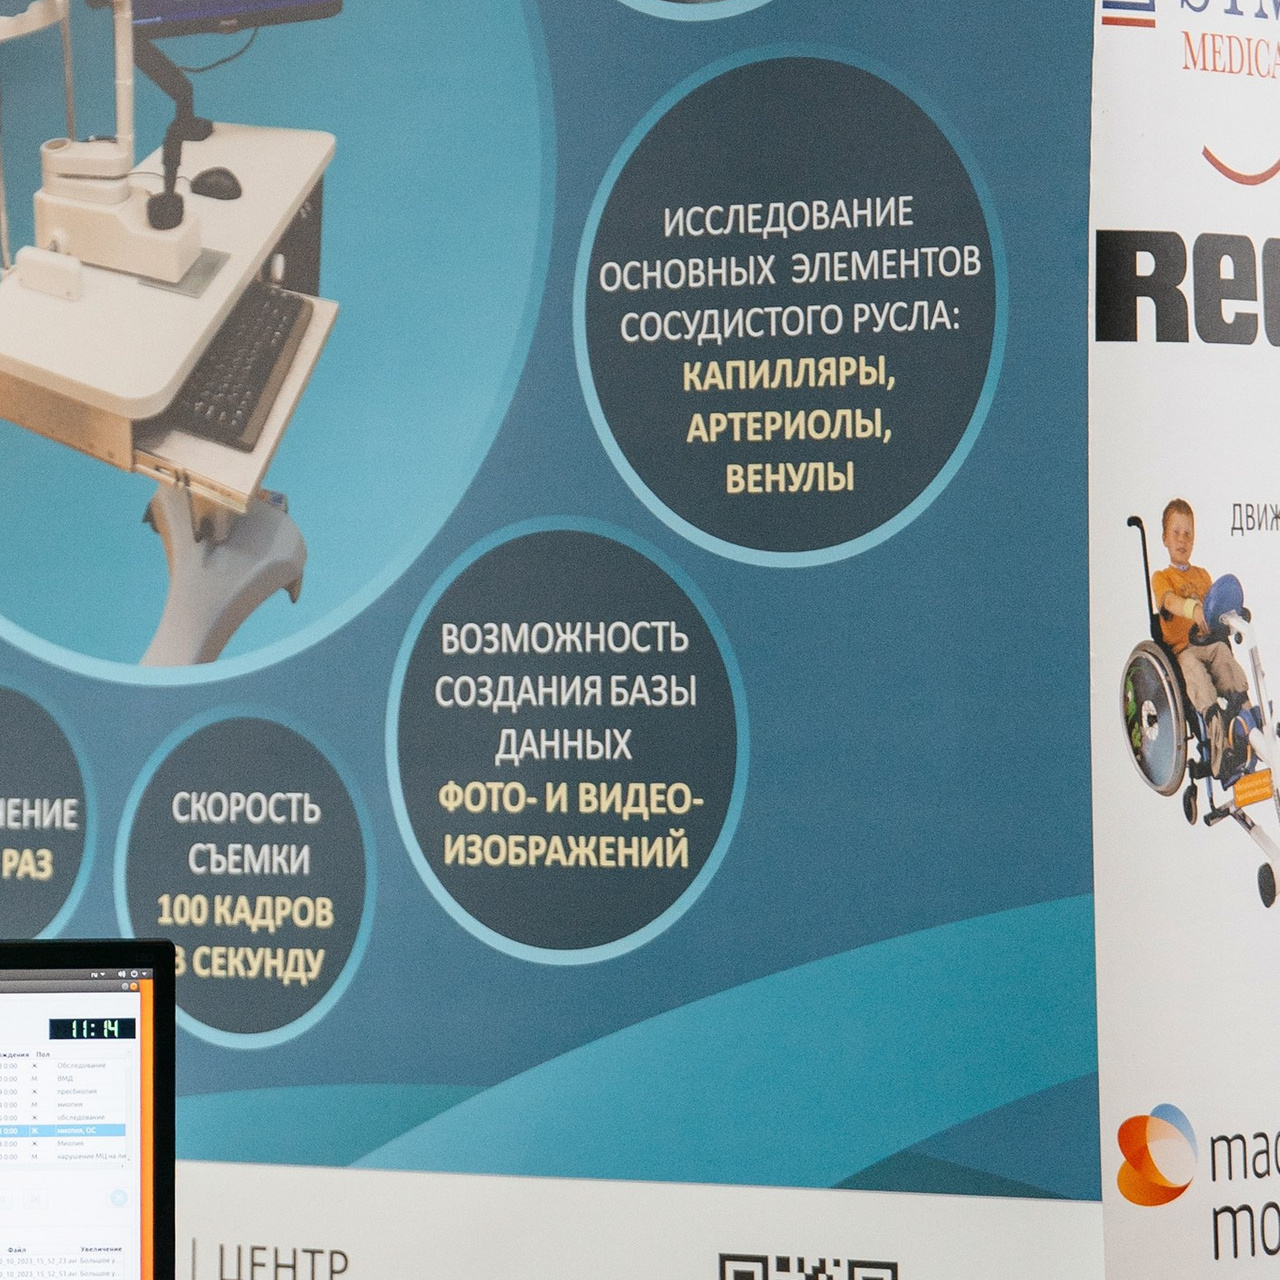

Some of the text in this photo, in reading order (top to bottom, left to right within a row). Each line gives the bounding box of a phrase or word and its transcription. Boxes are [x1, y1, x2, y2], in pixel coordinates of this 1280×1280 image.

[663, 195, 915, 239] ИССЛЕДОВАНИЕ
[598, 245, 982, 292] ОСНОВНЫХ ЭЛЕМЕНТОВ
[1095, 229, 1280, 348] Re
[620, 300, 962, 346] СОСУДИСТОГО РУСЛА:
[682, 355, 897, 393] КАПИЛЛЯРЫ,
[685, 408, 894, 445] АРТЕРИОЛЫ,
[725, 461, 856, 496] ВЕНУЛЫ
[440, 619, 691, 655] ВОЗМОЖНОСТЬ
[434, 672, 698, 712] СОЗДАНИЯ БАЗЫ
[494, 726, 634, 769] ДАННЫХ
[170, 790, 322, 826] СКОРОСТЬ
[437, 778, 705, 822] ФОТО- И ВИДЕО-
[2, 846, 54, 882] РАЗ
[188, 841, 311, 880] СЪЕМКИ
[443, 828, 691, 871] ИЗОБРАЖЕНИЙ
[157, 892, 336, 934] 100 КАДРОВ
[192, 944, 326, 987] СЕКУНДУ
[71, 1019, 119, 1038] 11:14
[7, 1246, 27, 1254] Файл
[80, 1245, 123, 1253] Увеличение
